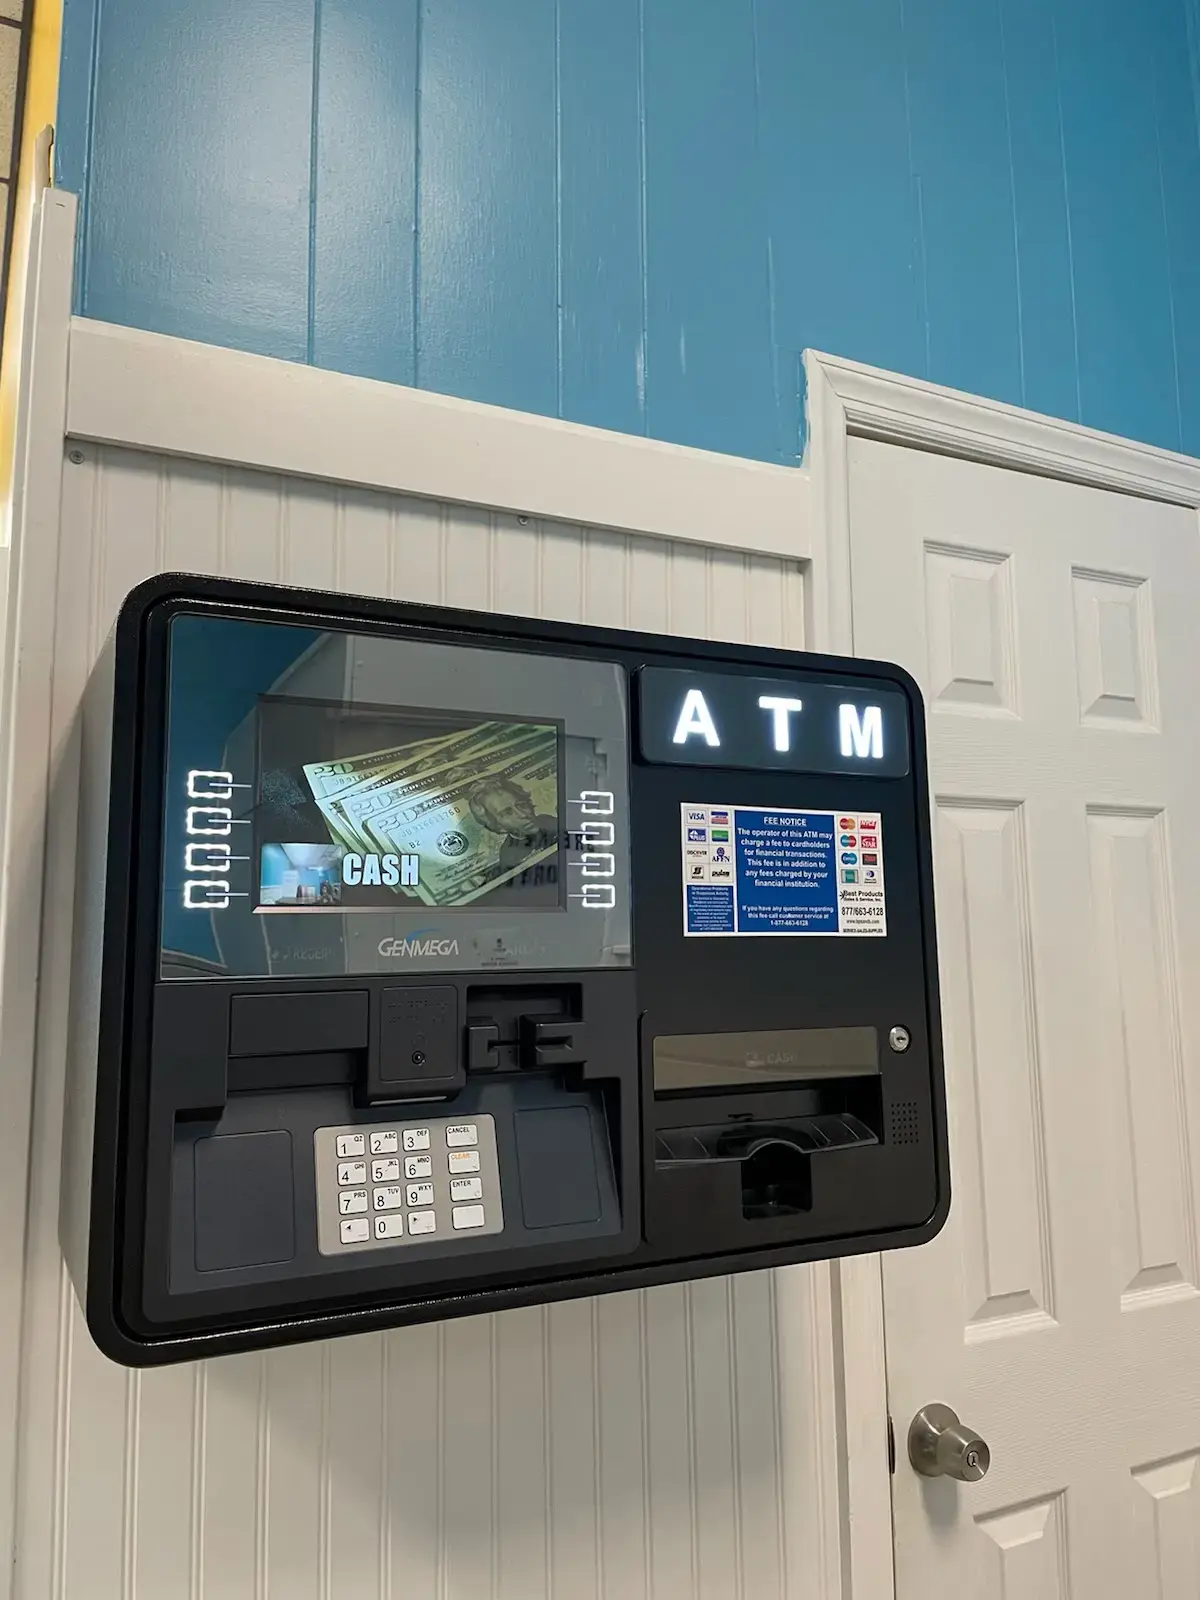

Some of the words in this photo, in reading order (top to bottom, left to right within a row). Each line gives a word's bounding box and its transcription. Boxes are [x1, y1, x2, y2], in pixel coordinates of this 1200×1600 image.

[689, 812, 705, 820] VISA
[764, 817, 778, 825] FEE
[780, 818, 807, 826] NOTICE
[752, 829, 780, 837] operator
[790, 830, 802, 838] this
[819, 832, 833, 840] may
[741, 838, 764, 847] charge
[791, 840, 830, 848] cardholders
[744, 848, 754, 856] for
[756, 849, 785, 857] financial
[786, 850, 828, 858] transactions.
[747, 858, 762, 866] This
[791, 860, 818, 868] addition
[343, 853, 419, 886] CASH
[745, 870, 758, 878] any
[775, 870, 802, 879] charged
[804, 870, 811, 879] by
[813, 872, 828, 880] your
[755, 879, 784, 887] financial
[785, 880, 820, 888] institution.
[842, 907, 884, 916] 877/663-6128
[378, 937, 459, 958] GENMEGA
[374, 1140, 382, 1152] 2
[407, 1137, 414, 1148] 3
[341, 1143, 346, 1154] 1
[376, 1168, 383, 1179] 5
[409, 1164, 416, 1176] 6
[342, 1171, 350, 1182] 4
[453, 1180, 471, 1188] ENTER
[377, 1196, 385, 1207] 8
[411, 1192, 418, 1203] 9
[344, 1199, 351, 1211] 7
[378, 1222, 386, 1234] 0
